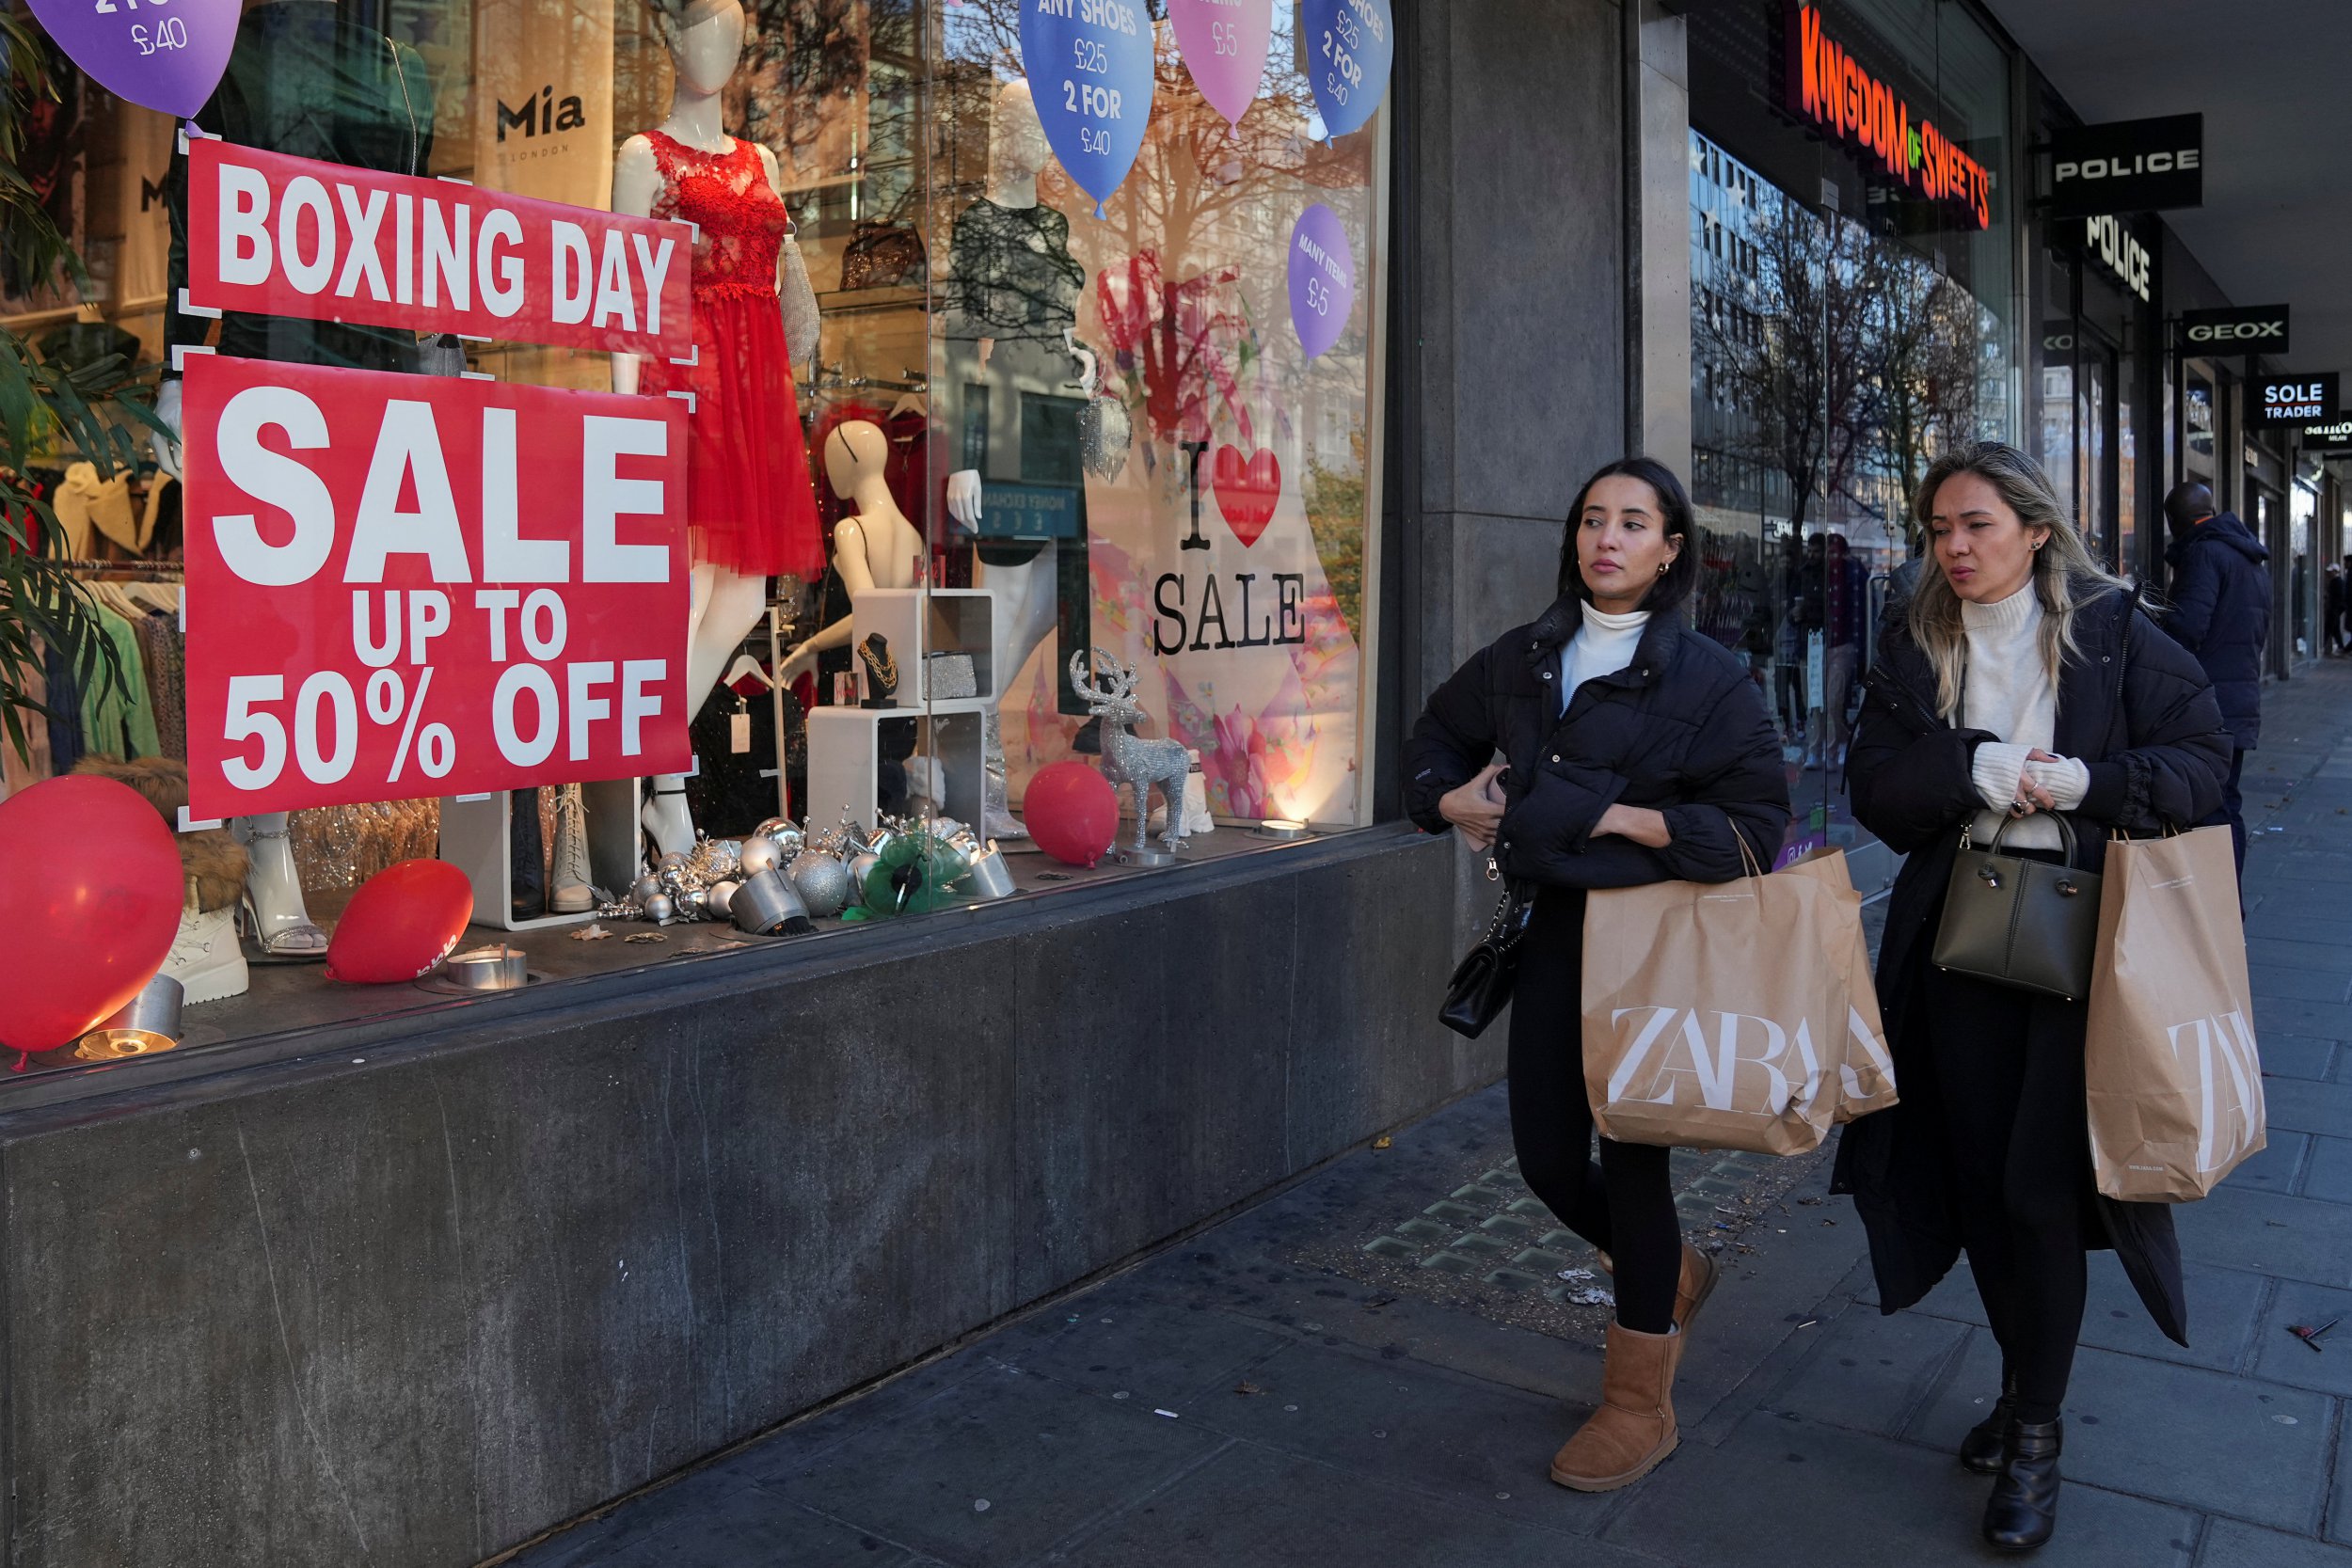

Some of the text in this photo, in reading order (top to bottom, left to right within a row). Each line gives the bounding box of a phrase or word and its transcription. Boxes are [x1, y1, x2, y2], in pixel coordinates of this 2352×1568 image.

[131, 17, 187, 55] £40
[1081, 0, 1136, 37] SHOES
[1212, 21, 1237, 56] £5
[1336, 9, 1359, 50] £25
[1074, 38, 1107, 74] £25
[1322, 30, 1362, 89] 2 FOR
[1063, 79, 1121, 119] 2 FOR
[1327, 72, 1348, 106] £40
[497, 85, 585, 143] Mia
[1801, 5, 1989, 230] KINGDOM OF SWEETS
[512, 144, 569, 163] LONDON
[1081, 127, 1110, 155] £40
[2056, 149, 2200, 182] POLICE
[218, 163, 675, 335] BOXING DAY
[1298, 233, 1347, 290] MANY ITEMS
[2087, 214, 2150, 303] POLICE
[1306, 277, 1329, 316] £5
[2187, 321, 2283, 341] GEOX
[2265, 383, 2323, 404] SOLE
[2265, 404, 2322, 420] TRADER
[212, 386, 670, 586] SALE
[1179, 440, 1211, 551] I
[352, 588, 567, 667] UP TO
[1153, 572, 1306, 657] SALE
[221, 659, 667, 790] 50% OFF
[1607, 1006, 1828, 1127] ZARA
